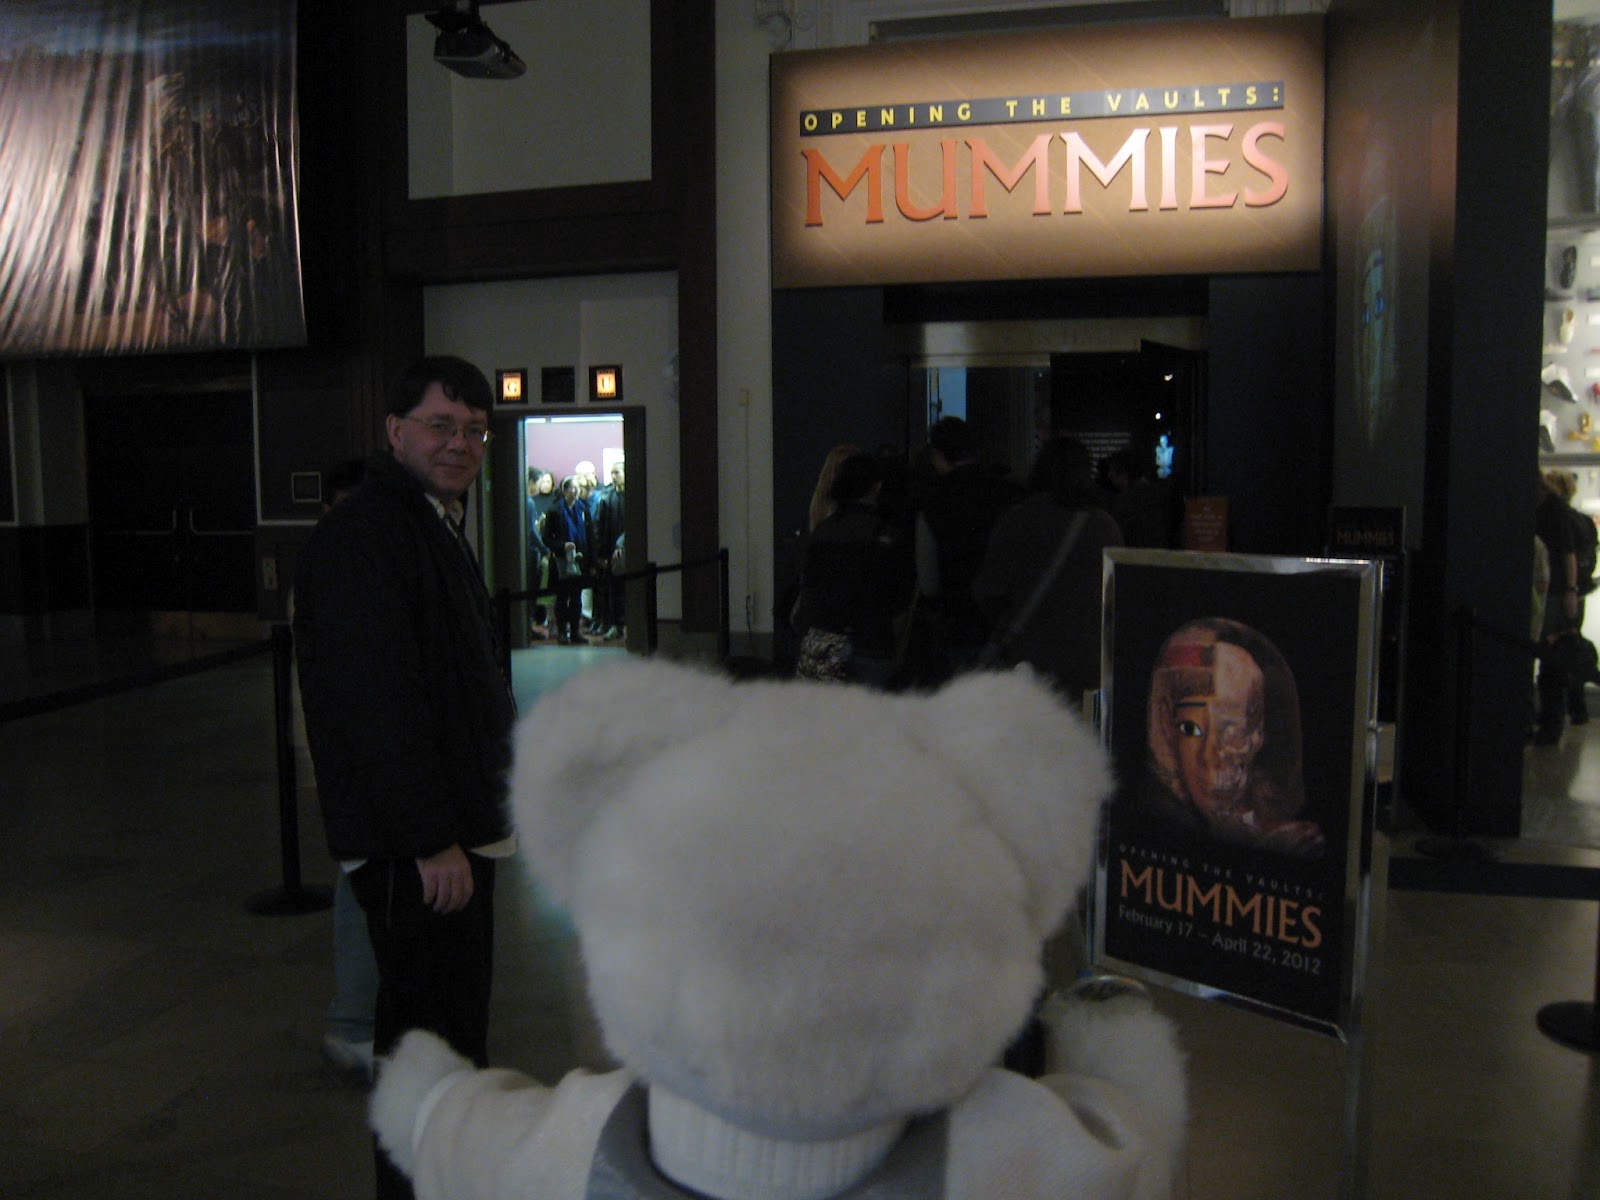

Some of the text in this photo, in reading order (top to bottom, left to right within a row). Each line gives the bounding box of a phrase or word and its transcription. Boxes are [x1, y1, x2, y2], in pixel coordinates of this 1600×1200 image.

[804, 86, 1280, 132] OPENING THE VAULTS:
[801, 122, 1289, 227] MUMMIES
[1119, 843, 1190, 869] OPENING
[1202, 863, 1233, 879] THE
[1119, 859, 1323, 949] MUMMIES
[1119, 904, 1174, 935] February
[1178, 921, 1193, 938] 17
[1212, 931, 1248, 955] April
[1252, 941, 1278, 966] 22,
[1282, 949, 1322, 975] 2012
